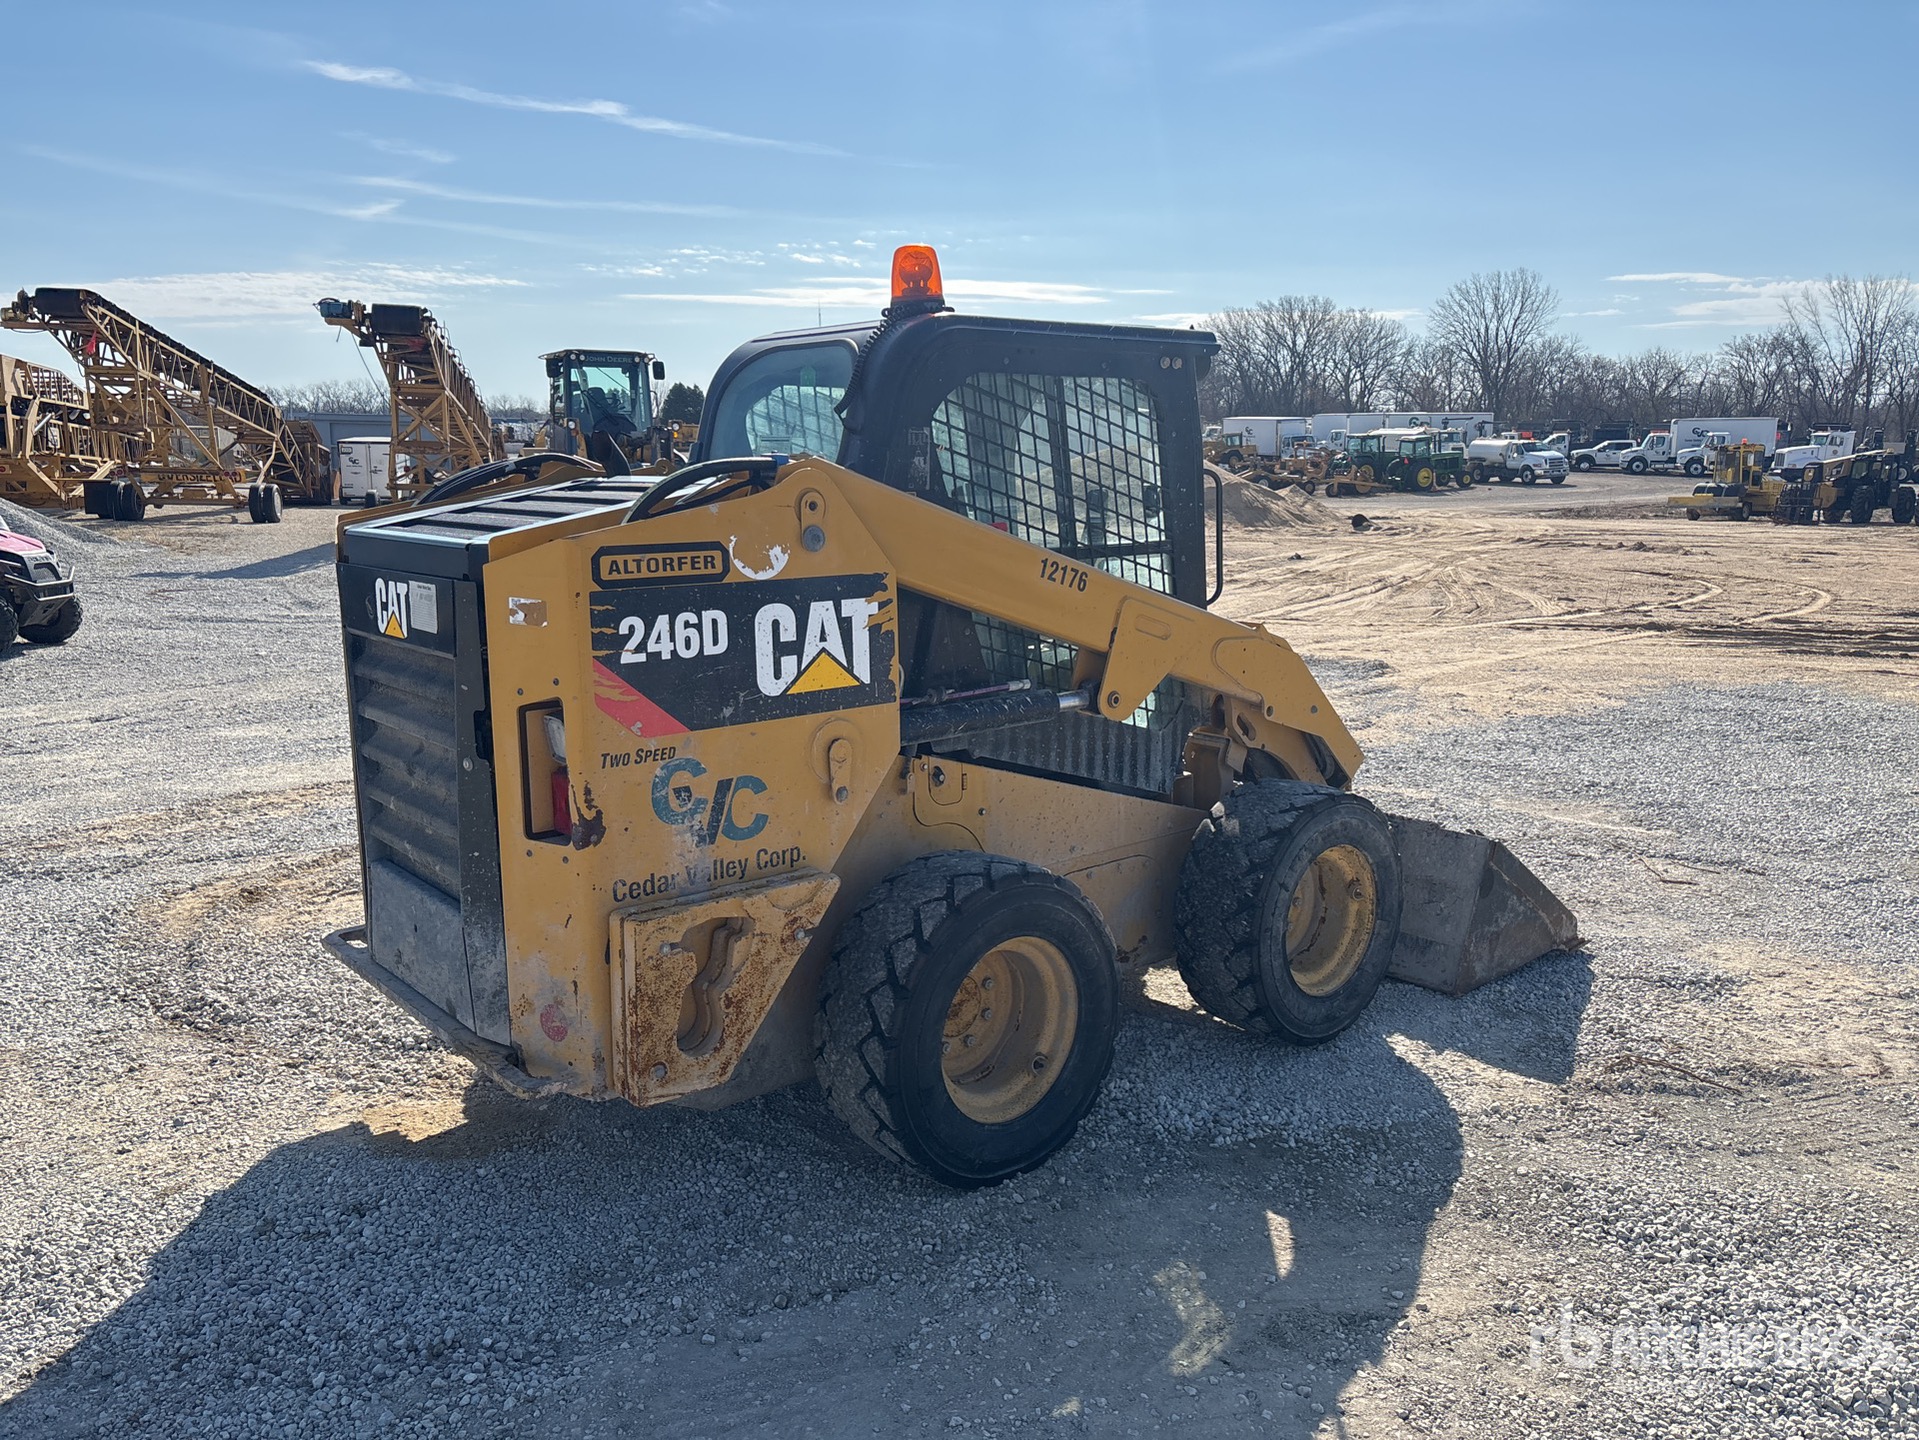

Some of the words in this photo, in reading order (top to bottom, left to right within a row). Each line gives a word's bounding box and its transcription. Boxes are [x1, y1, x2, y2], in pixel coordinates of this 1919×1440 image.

[607, 554, 717, 575] ALTORFER
[1040, 557, 1089, 592] 12176
[375, 577, 408, 638] CAT
[618, 609, 728, 664] 246D
[754, 598, 879, 696] CAT
[612, 871, 680, 903] Cedar
[685, 856, 749, 888] Vlley
[756, 845, 806, 870] Corp.
